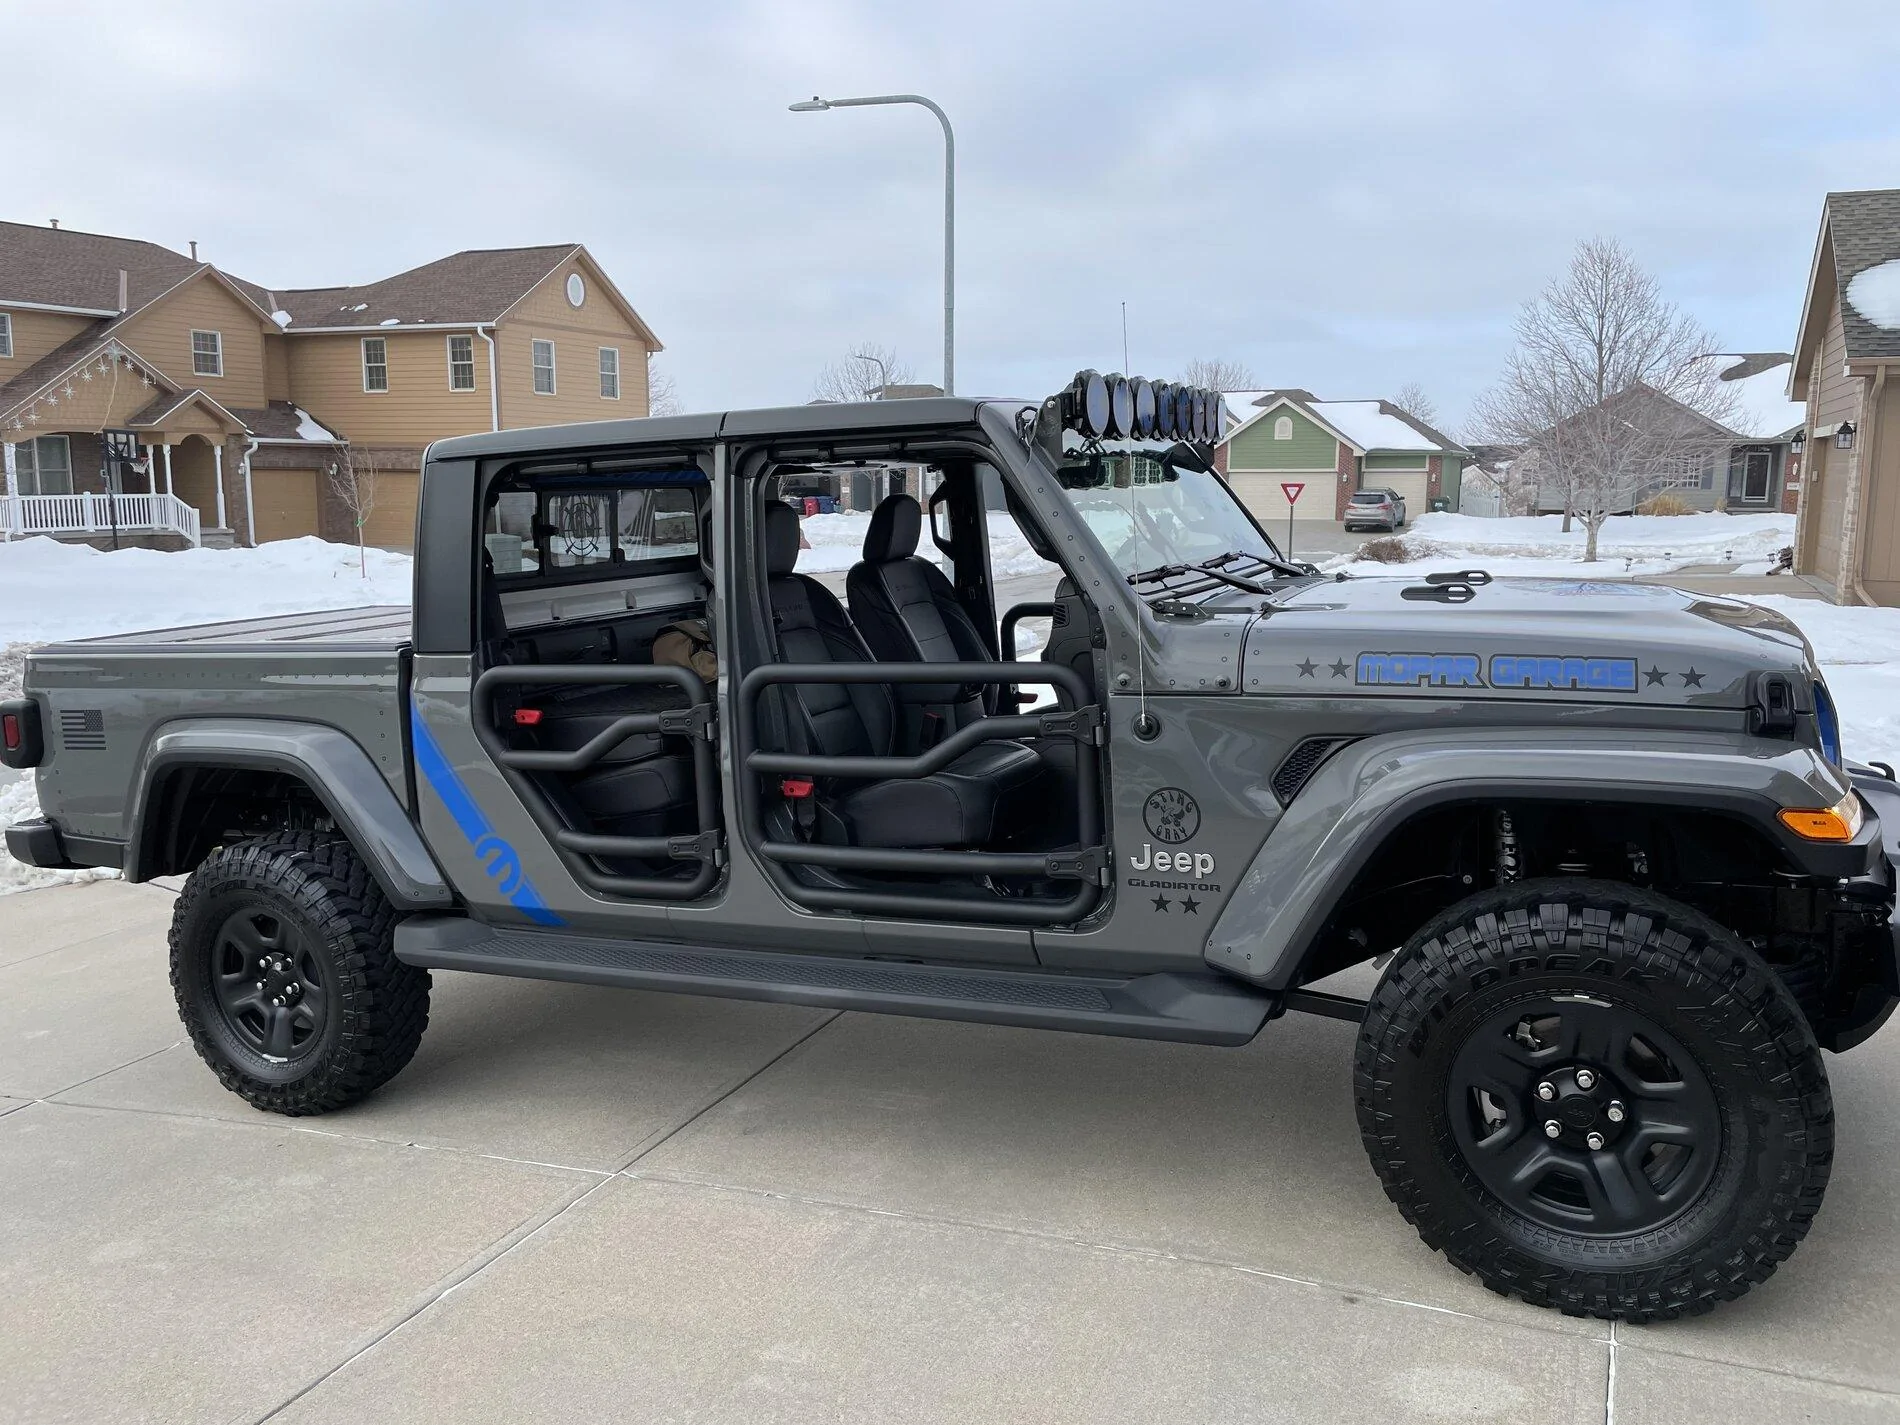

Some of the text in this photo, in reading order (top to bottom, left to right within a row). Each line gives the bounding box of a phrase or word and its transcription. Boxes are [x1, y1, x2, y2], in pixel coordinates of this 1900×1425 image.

[1356, 652, 1638, 693] MOPAR GARAGE
[1150, 791, 1194, 813] STING
[1156, 825, 1188, 841] GRAY
[1130, 844, 1216, 879] Jeep
[1128, 878, 1221, 892] GLADIATOR
